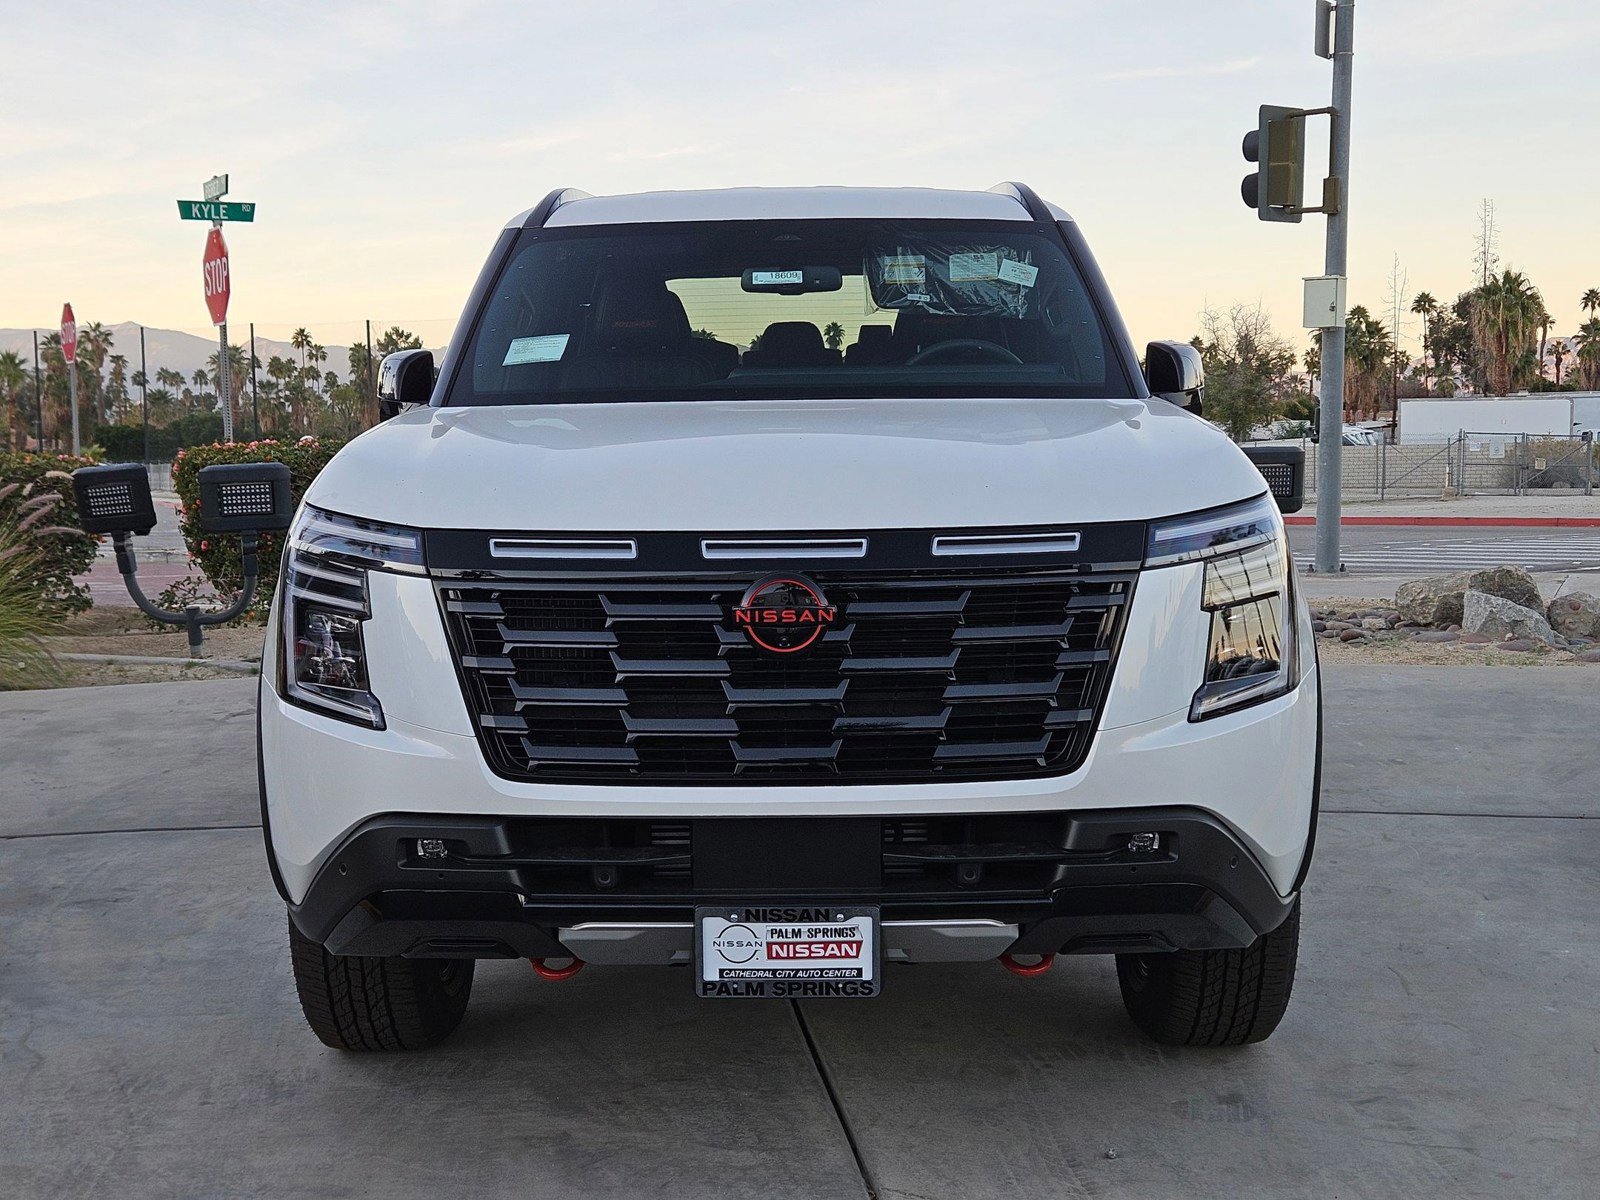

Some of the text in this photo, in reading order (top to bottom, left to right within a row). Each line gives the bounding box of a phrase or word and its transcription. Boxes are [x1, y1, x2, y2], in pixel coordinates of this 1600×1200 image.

[191, 203, 251, 220] KYLE RD
[204, 256, 228, 297] STOP
[735, 609, 834, 623] NISSAN
[744, 908, 830, 922] NISSAN
[770, 927, 856, 939] PALM SPRINGS
[712, 940, 763, 948] NISSAN
[771, 943, 857, 958] NISSAN
[723, 970, 774, 979] CATHEDRAL
[775, 970, 796, 978] CITY
[822, 969, 858, 977] CENTER
[702, 981, 874, 996] PALM SPRINGS
